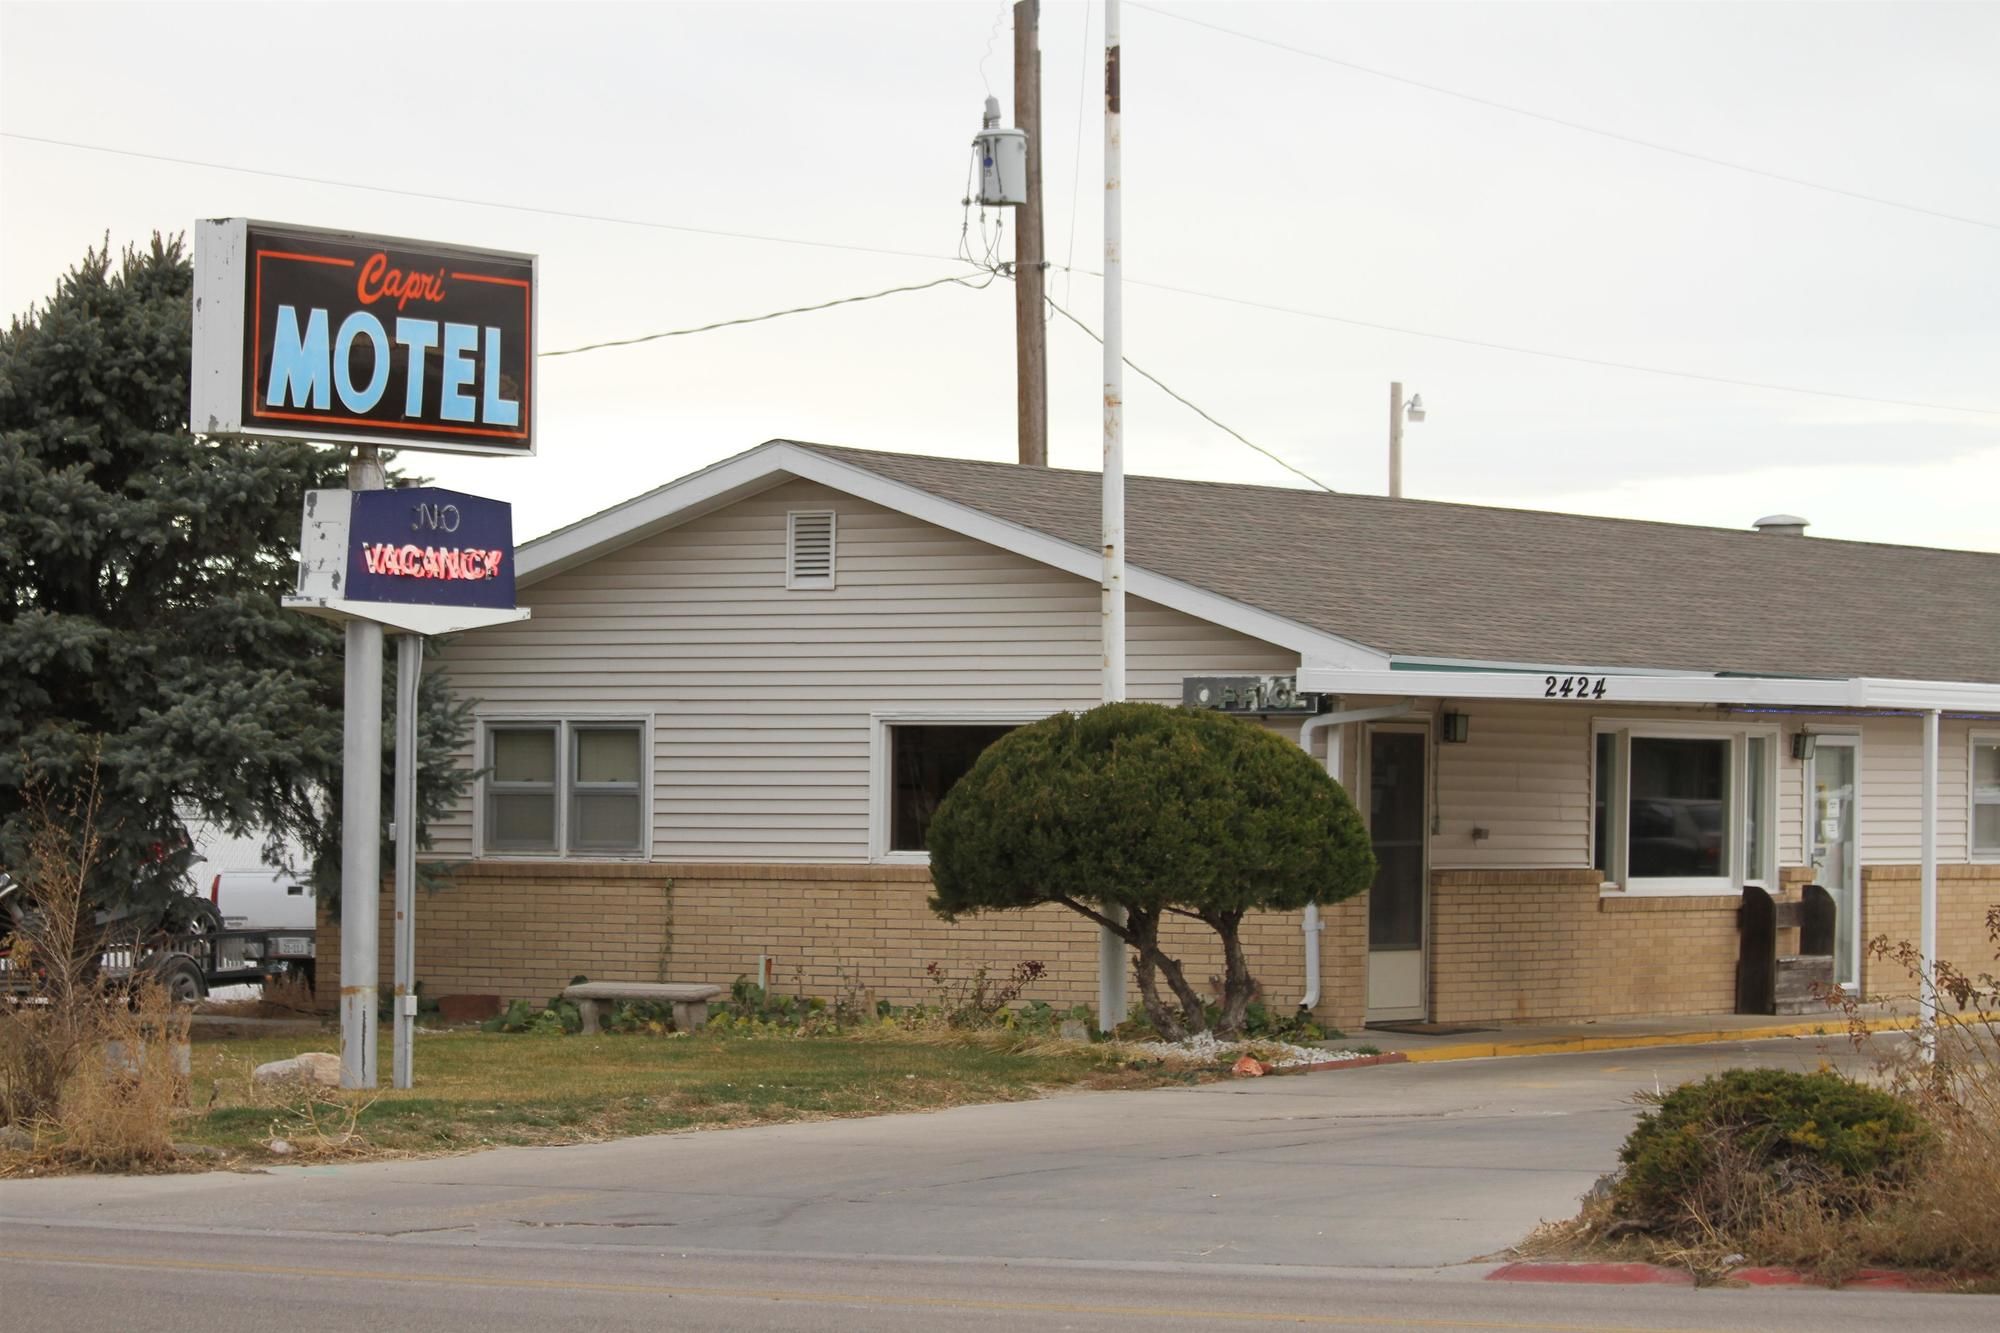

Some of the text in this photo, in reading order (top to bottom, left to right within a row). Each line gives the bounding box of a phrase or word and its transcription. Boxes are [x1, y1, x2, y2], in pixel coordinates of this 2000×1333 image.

[357, 253, 446, 310] Capri
[266, 304, 519, 426] MOTEL
[412, 503, 460, 532] NO
[362, 541, 503, 580] VACANCY
[1545, 676, 1606, 699] 2424
